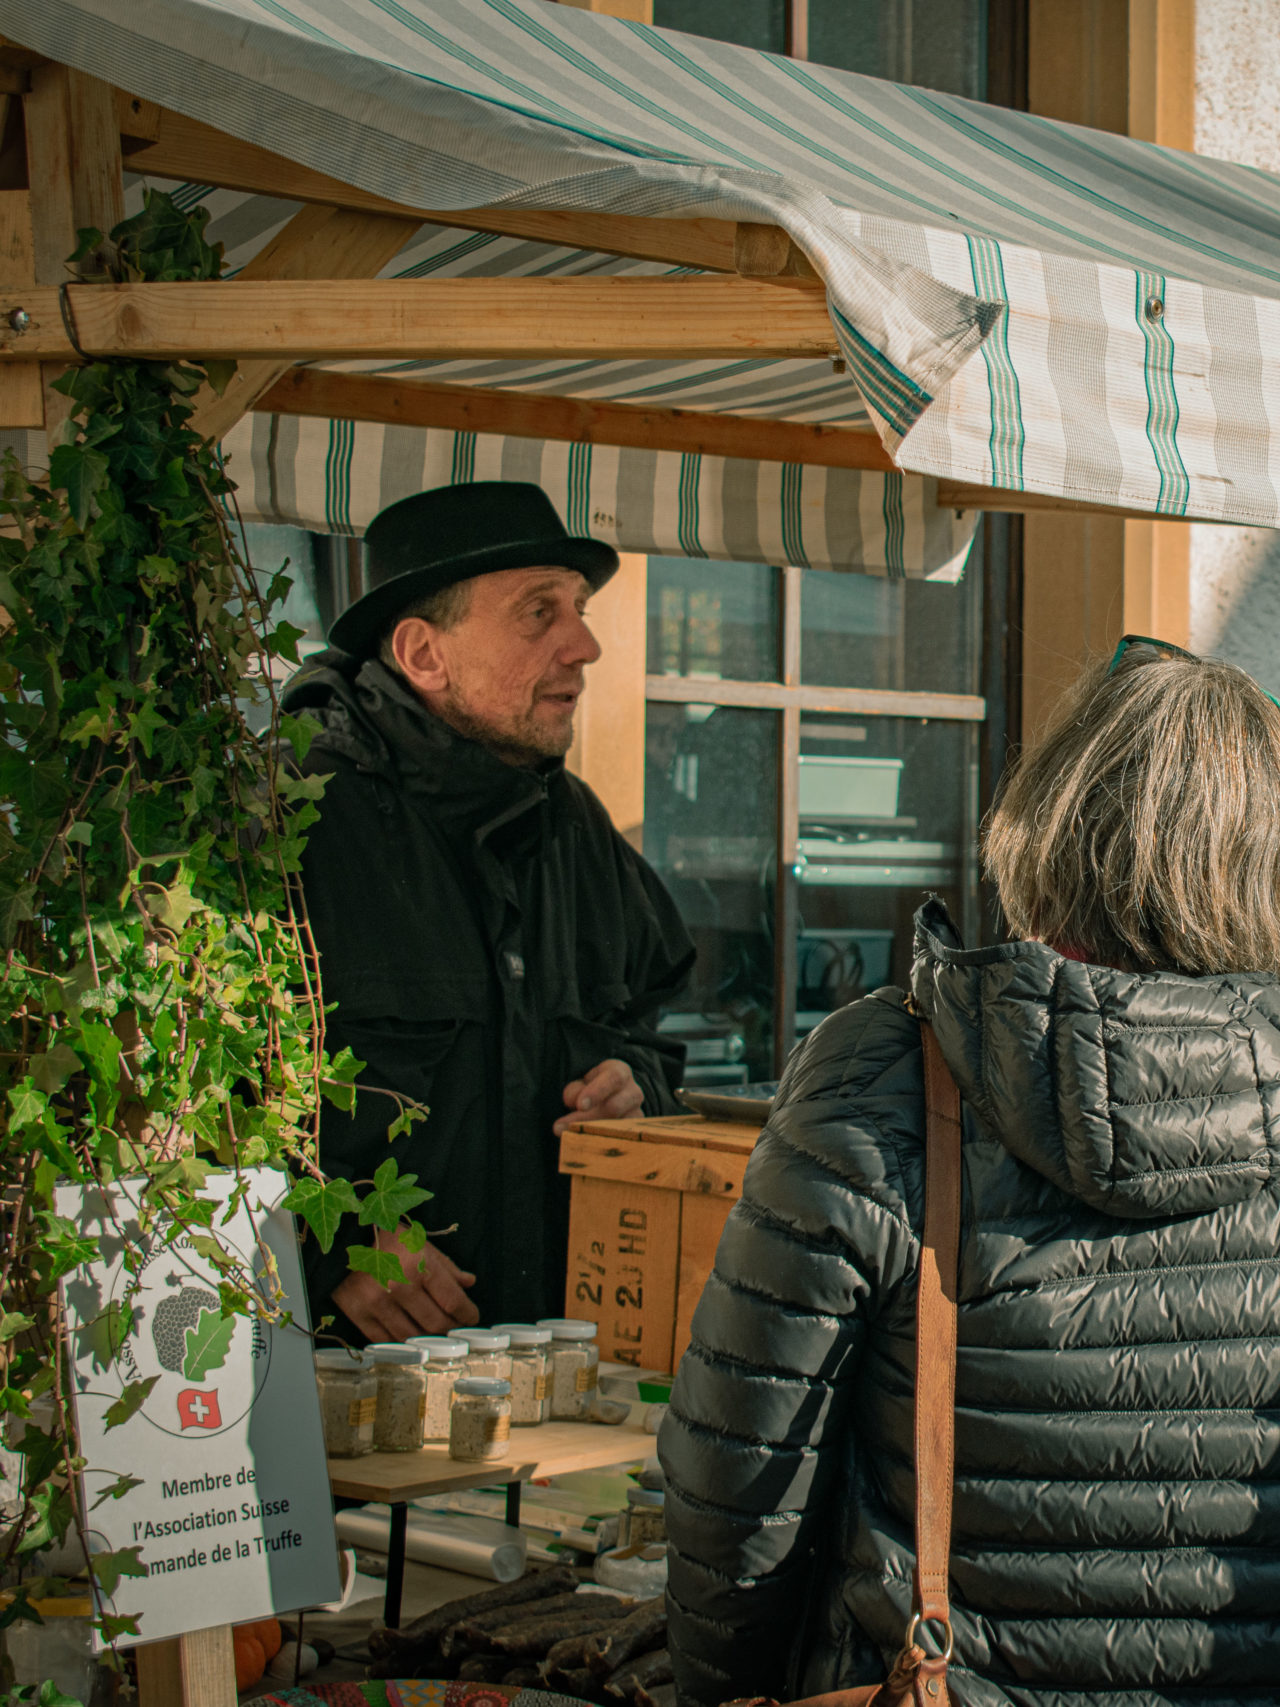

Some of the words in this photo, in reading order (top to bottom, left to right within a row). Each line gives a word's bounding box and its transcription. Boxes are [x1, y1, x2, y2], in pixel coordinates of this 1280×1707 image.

[618, 1207, 648, 1256] HD
[162, 1472, 232, 1499] Membre
[237, 1466, 256, 1486] de
[241, 1499, 290, 1521] Suisse
[148, 1548, 207, 1577] mande
[211, 1544, 232, 1564] de
[236, 1540, 250, 1559] la
[254, 1529, 302, 1555] Truffe
